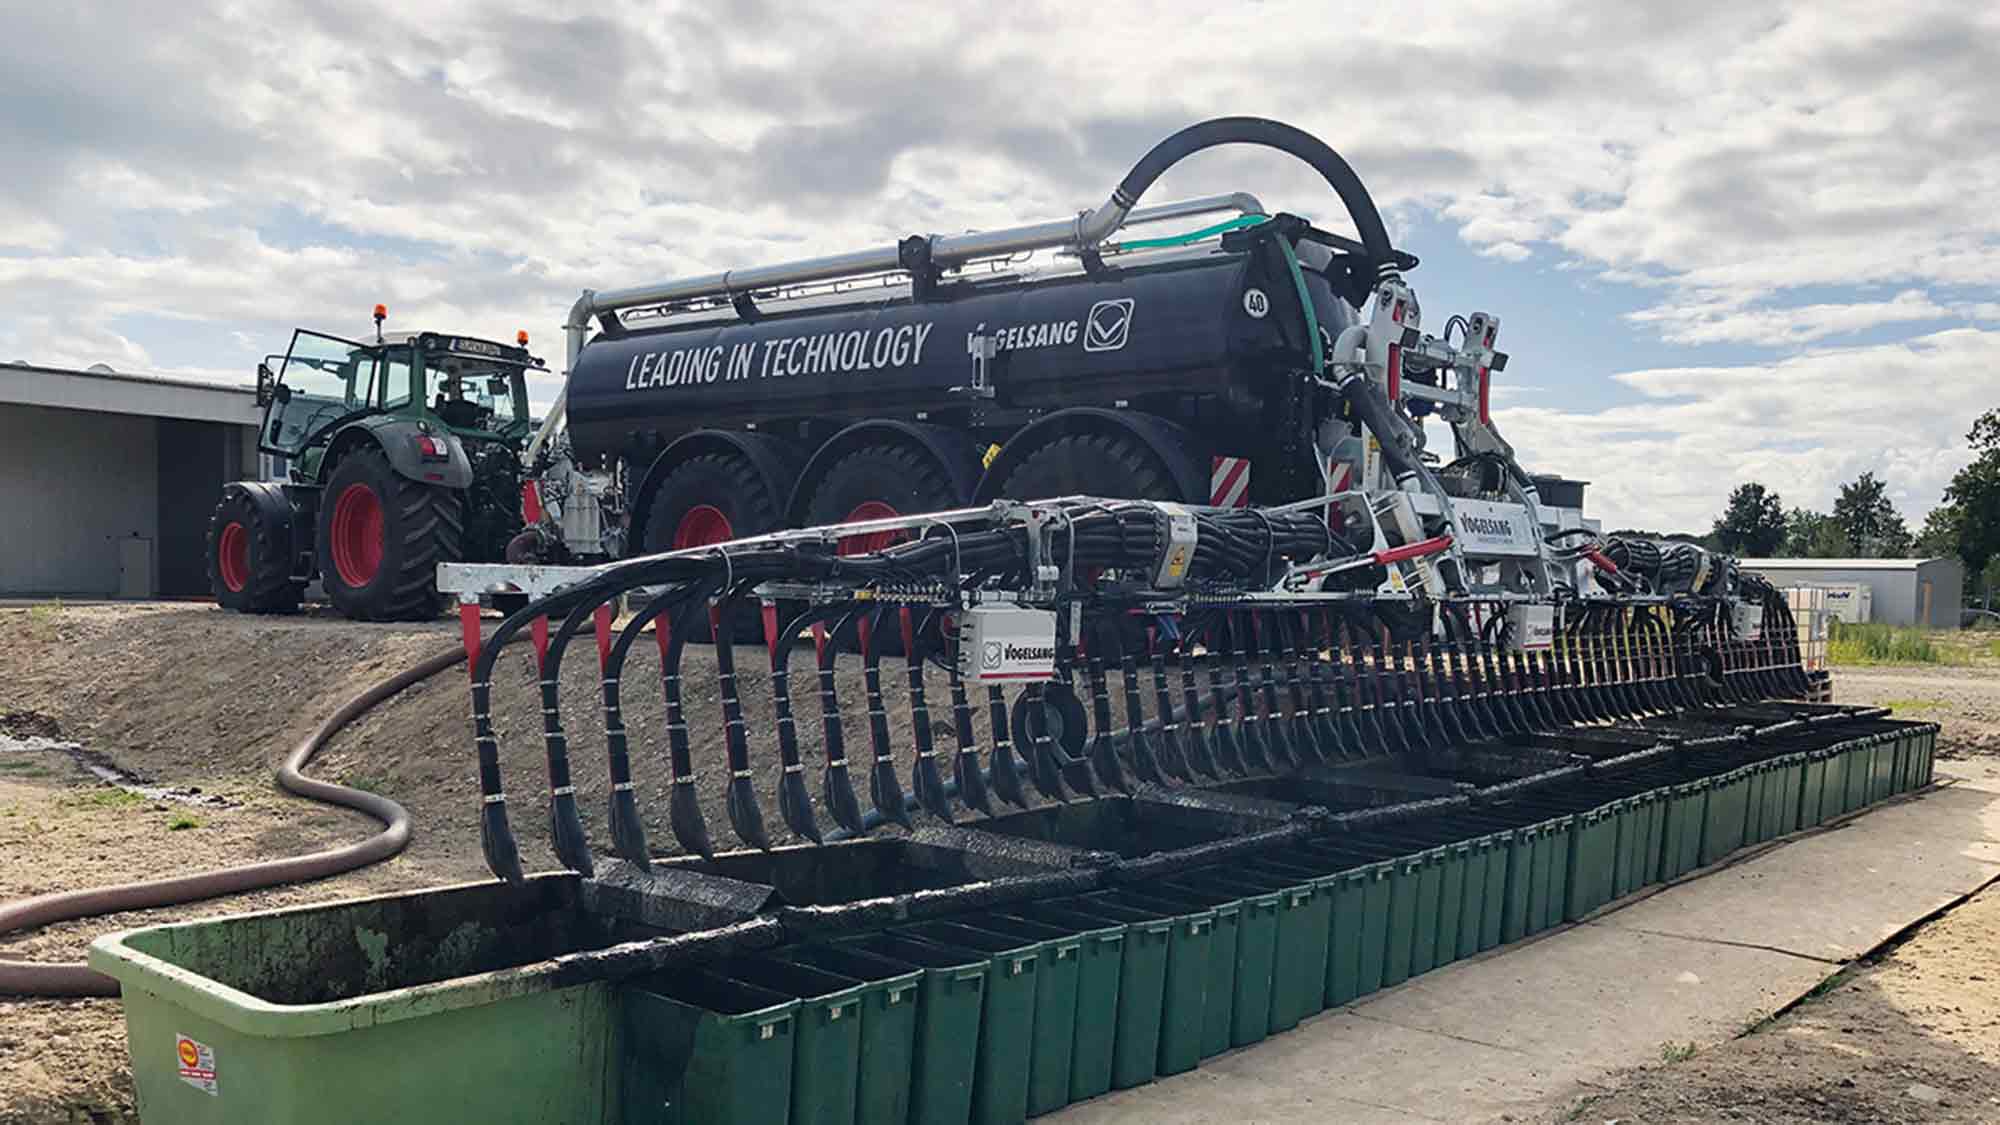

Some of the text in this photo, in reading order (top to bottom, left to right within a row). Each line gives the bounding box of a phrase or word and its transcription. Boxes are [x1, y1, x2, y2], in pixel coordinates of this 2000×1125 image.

[1249, 294, 1265, 312] 40
[967, 320, 1079, 353] VGELSANG
[625, 322, 933, 390] LEADING IN TECHNOLOGY
